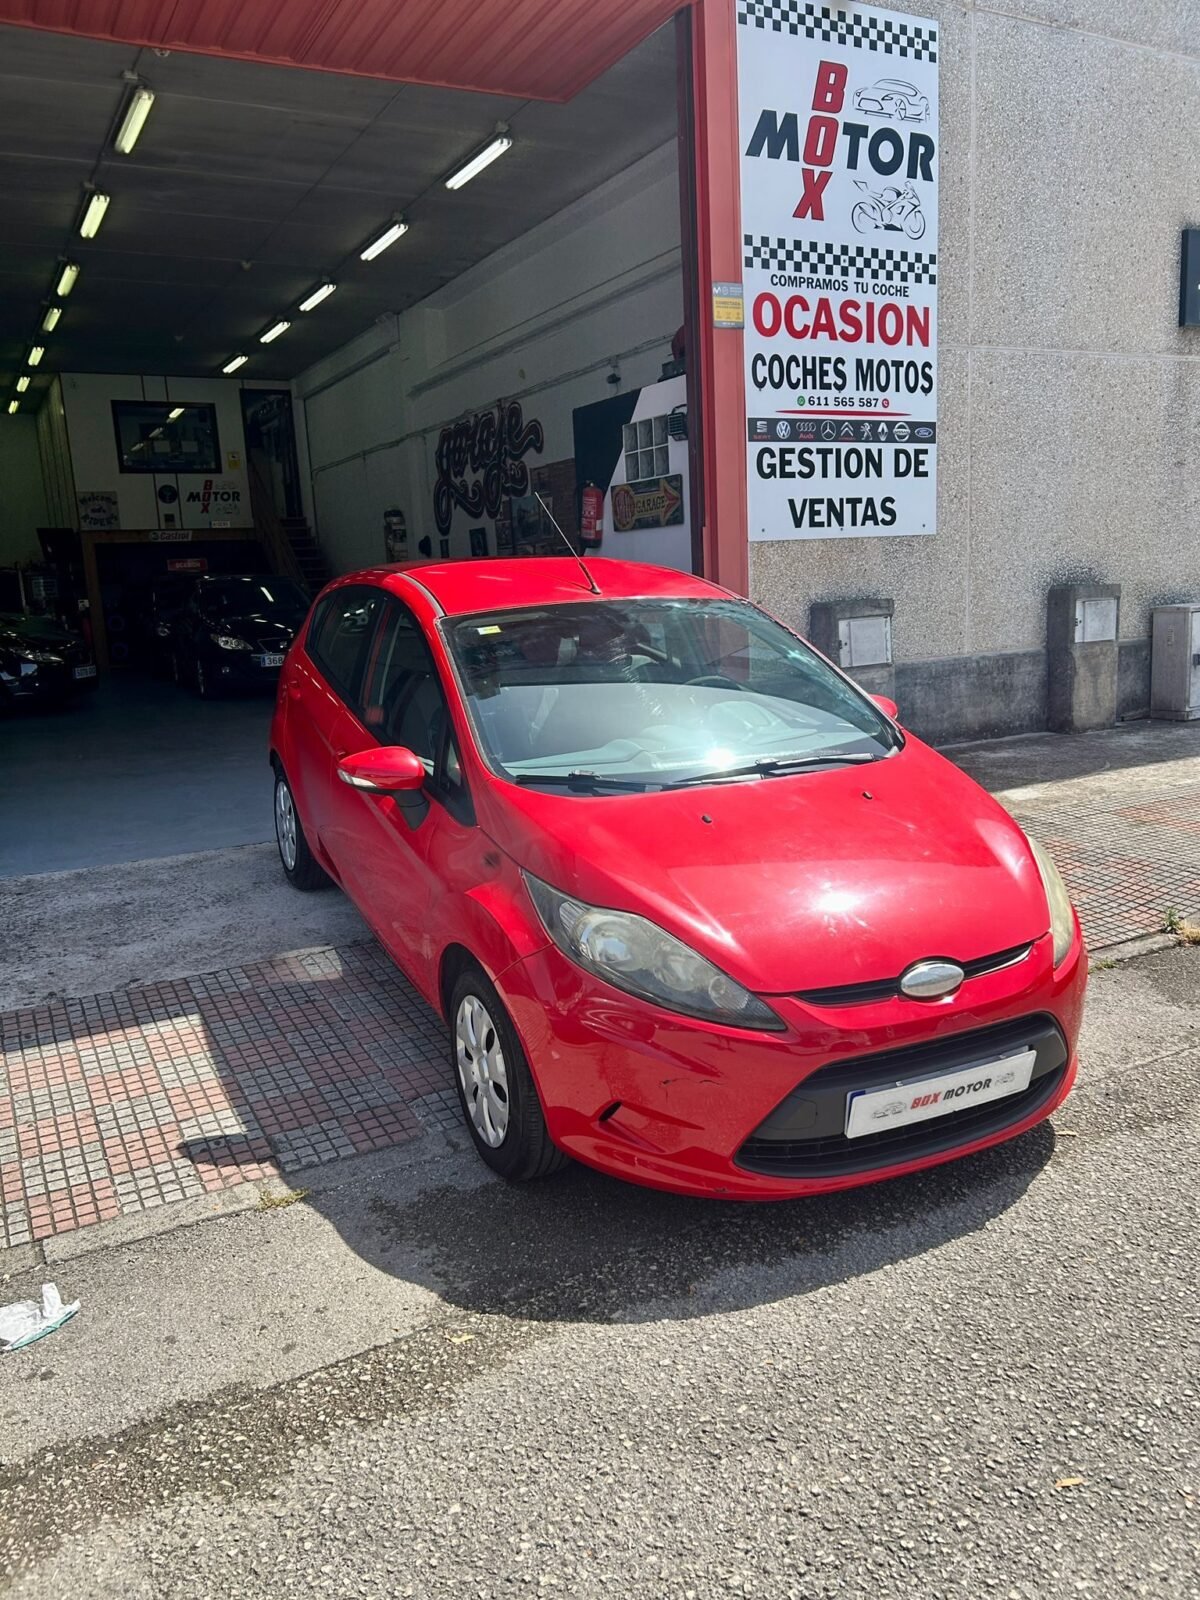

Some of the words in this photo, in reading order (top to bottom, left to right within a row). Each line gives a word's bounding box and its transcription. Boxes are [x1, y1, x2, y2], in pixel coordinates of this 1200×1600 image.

[745, 109, 935, 182] MOTOR
[792, 60, 848, 222] BOX
[770, 274, 848, 292] COMPRAMOS
[854, 281, 869, 294] TU
[872, 282, 910, 298] COCHE
[752, 292, 930, 347] OCASION
[751, 353, 847, 392] COCHES
[856, 357, 934, 395] MOTOS
[808, 396, 830, 407] 611
[834, 397, 856, 408] 565
[858, 397, 880, 408] 587
[755, 447, 883, 479] GESTION
[894, 448, 930, 478] DE
[186, 490, 241, 503] MOTOR
[635, 495, 666, 514] GARAGE
[787, 496, 897, 529] VENTAS
[160, 531, 190, 541] Castrol
[910, 1091, 941, 1109] BOX
[943, 1078, 992, 1101] MOTOR
